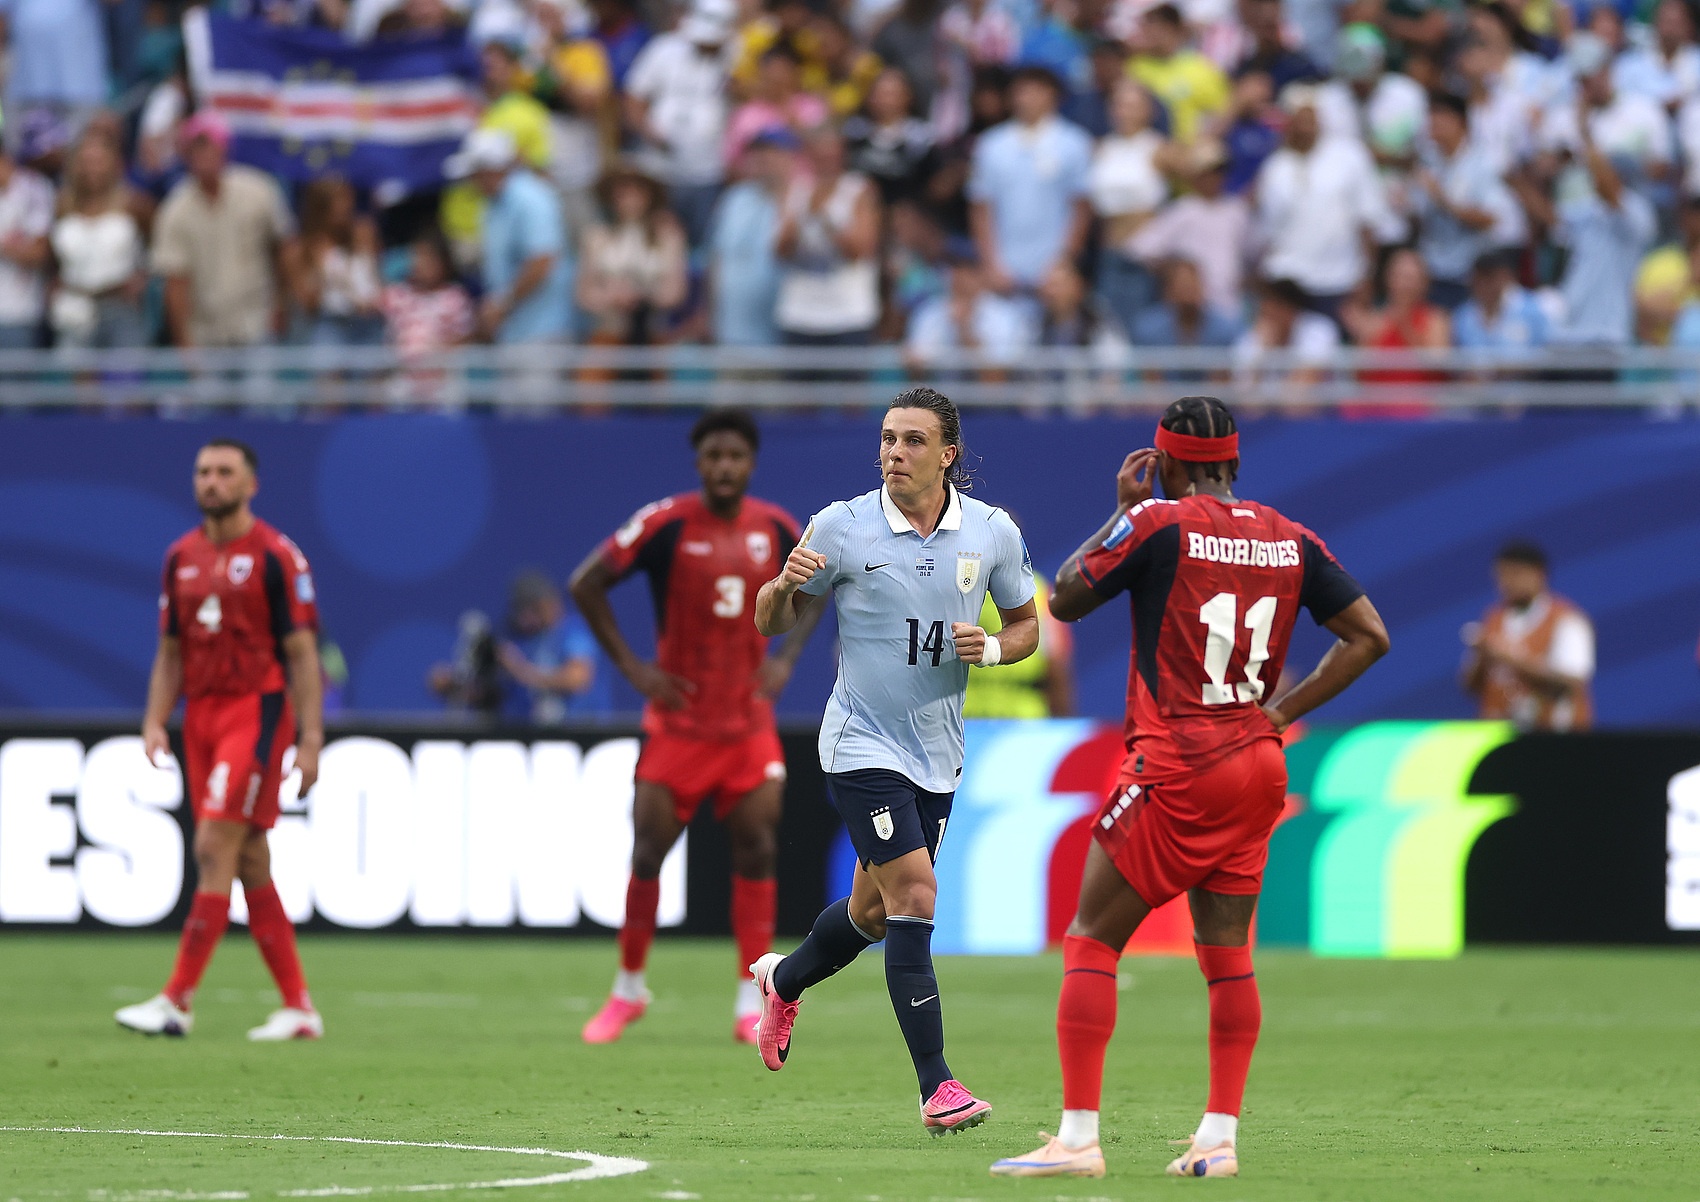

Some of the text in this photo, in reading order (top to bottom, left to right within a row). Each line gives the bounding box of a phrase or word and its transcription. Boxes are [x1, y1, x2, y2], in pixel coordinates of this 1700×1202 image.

[1187, 532, 1300, 567] RODRIGUES
[196, 594, 222, 633] 4
[712, 574, 746, 619] 3
[906, 618, 944, 667] 14
[1199, 592, 1278, 705] 11
